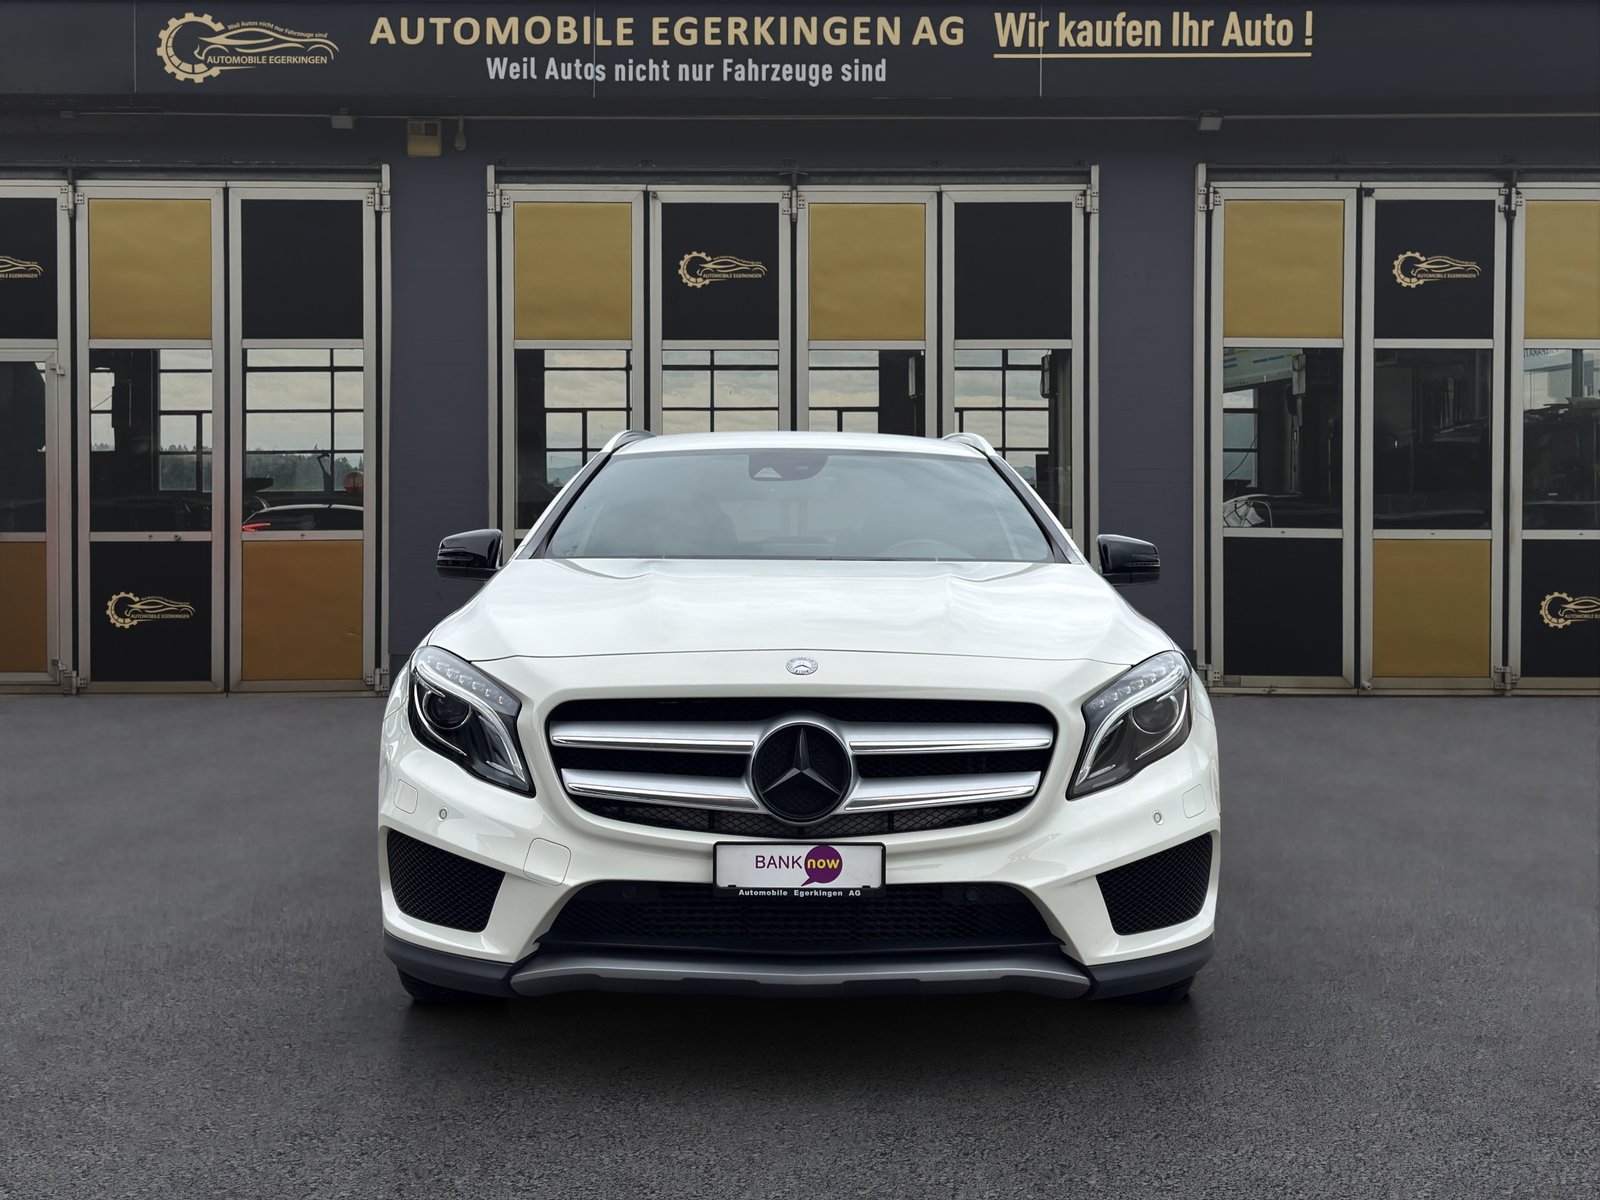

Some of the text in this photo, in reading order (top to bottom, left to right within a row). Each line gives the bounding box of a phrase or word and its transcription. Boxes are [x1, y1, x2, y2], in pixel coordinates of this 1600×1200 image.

[258, 20, 274, 29] nicht
[273, 25, 284, 33] nur
[284, 27, 314, 38] Fahrzeuge
[370, 16, 964, 47] AUTOMOBILE EGERKINGEN AG
[994, 10, 1313, 47] Wir kaufen Ihr Auto !
[206, 55, 327, 64] AUTOMOBILE EGERKINGEN
[487, 57, 887, 87] Weil Autos nicht nur Fahrzeuge sind
[755, 855, 840, 869] BANK now
[793, 889, 843, 897] Egerkingen
[848, 889, 861, 897] AG
